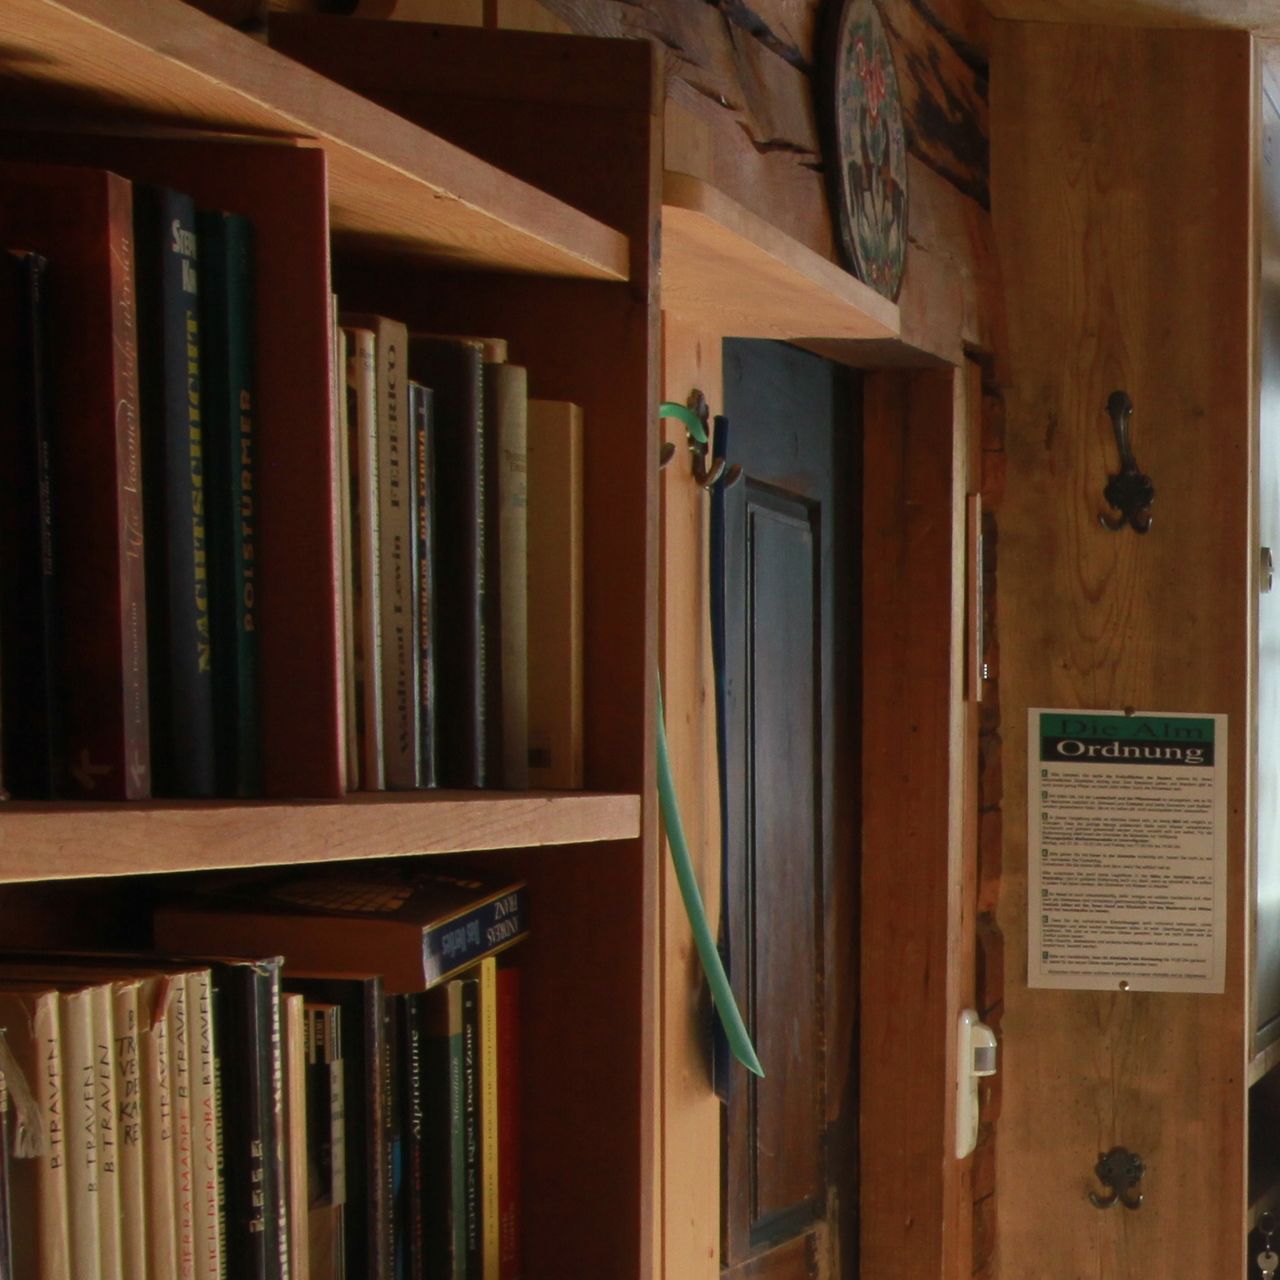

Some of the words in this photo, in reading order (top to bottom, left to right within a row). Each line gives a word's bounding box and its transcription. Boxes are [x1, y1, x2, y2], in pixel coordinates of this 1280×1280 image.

[386, 342, 401, 508] FEDERICO
[391, 534, 404, 614] Lewin
[1056, 738, 1205, 765] Ordnung
[1061, 719, 1119, 737] Die
[1132, 722, 1204, 740] Alm
[175, 986, 187, 1074] TRAVEN
[198, 981, 210, 1073] TRAVEN
[464, 1023, 474, 1068] Zone
[47, 1038, 61, 1149] TRAVEN
[83, 1066, 97, 1169] TRAVEN
[98, 1044, 114, 1147] TRAVEN
[465, 1068, 474, 1113] Dead
[179, 1111, 190, 1193] MADRE
[202, 1096, 215, 1172] CAOBA
[182, 1199, 193, 1278] SIERRA
